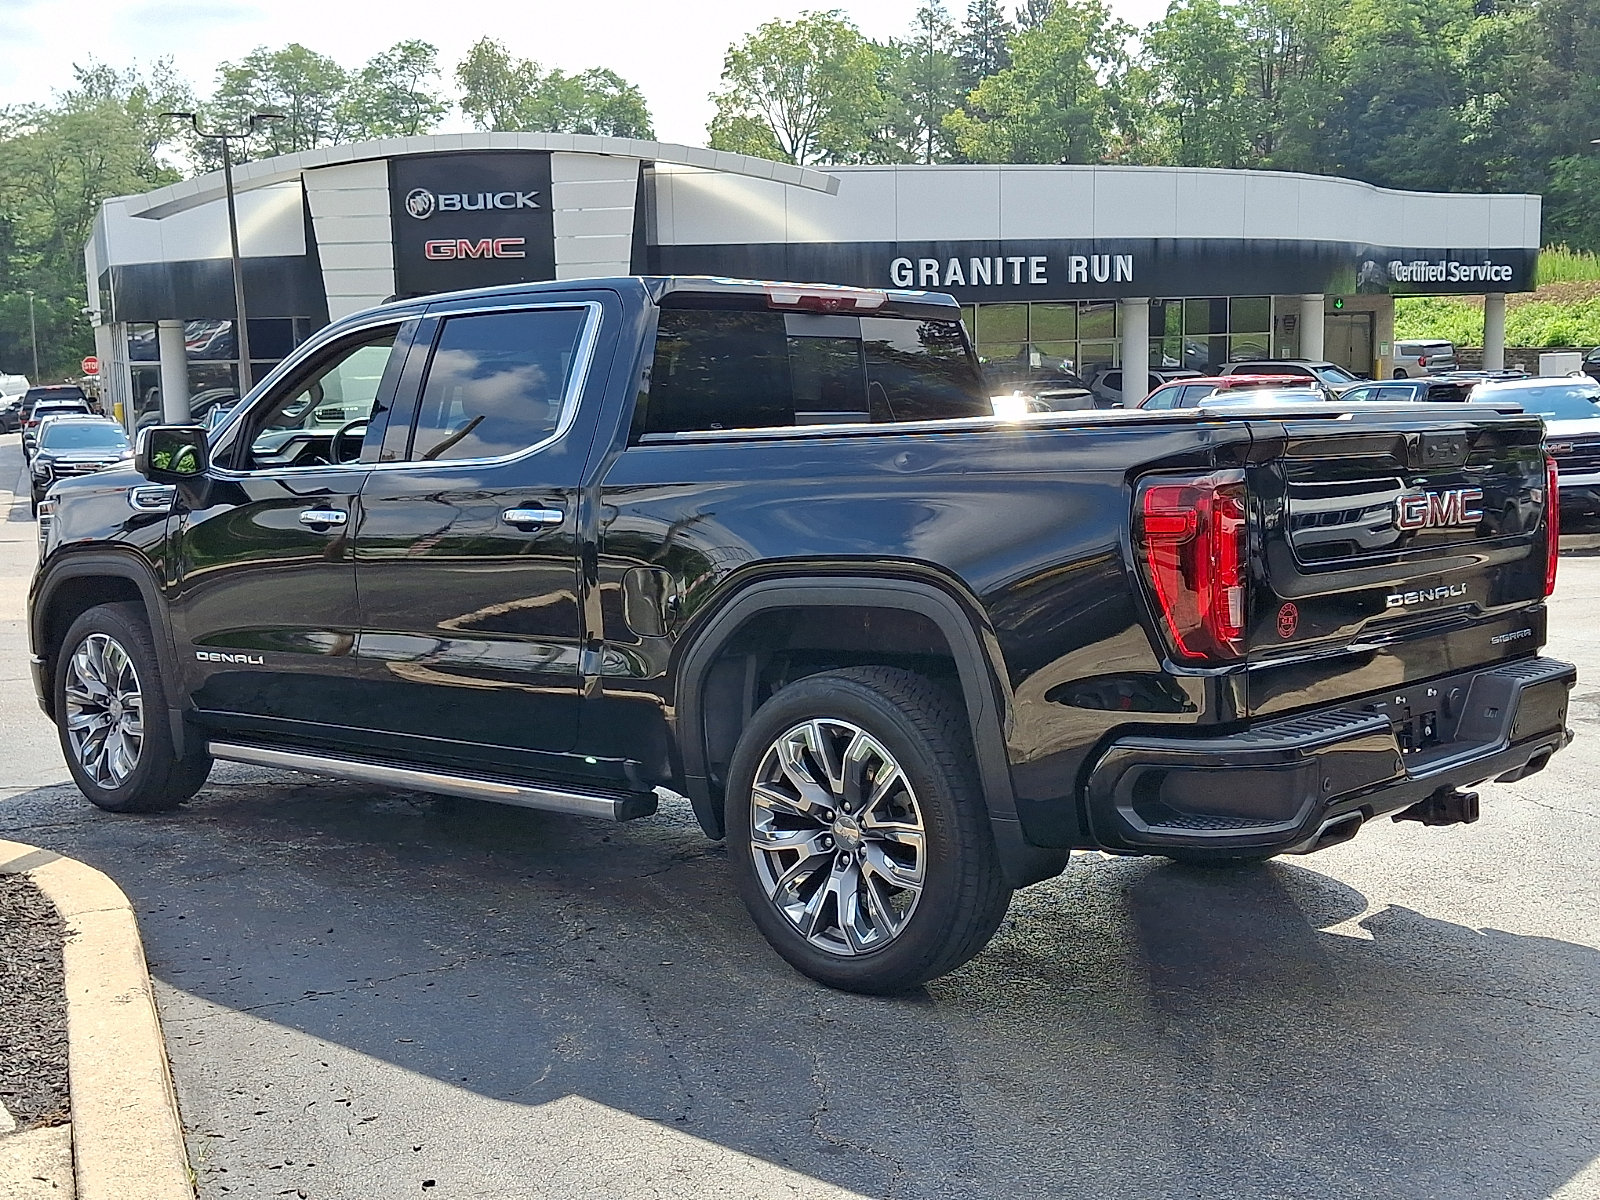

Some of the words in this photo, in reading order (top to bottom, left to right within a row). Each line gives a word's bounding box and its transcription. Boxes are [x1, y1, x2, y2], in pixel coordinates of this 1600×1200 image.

[438, 191, 541, 211] BUICK
[425, 238, 525, 260] GMC
[890, 256, 1048, 287] GRANITE
[1068, 255, 1133, 283] RUN
[1394, 260, 1446, 282] Certified
[1448, 260, 1513, 282] Service
[1395, 487, 1484, 531] GMC
[1386, 583, 1467, 608] DENALI
[1491, 628, 1532, 645] SIERRA
[195, 651, 264, 665] DENALI
